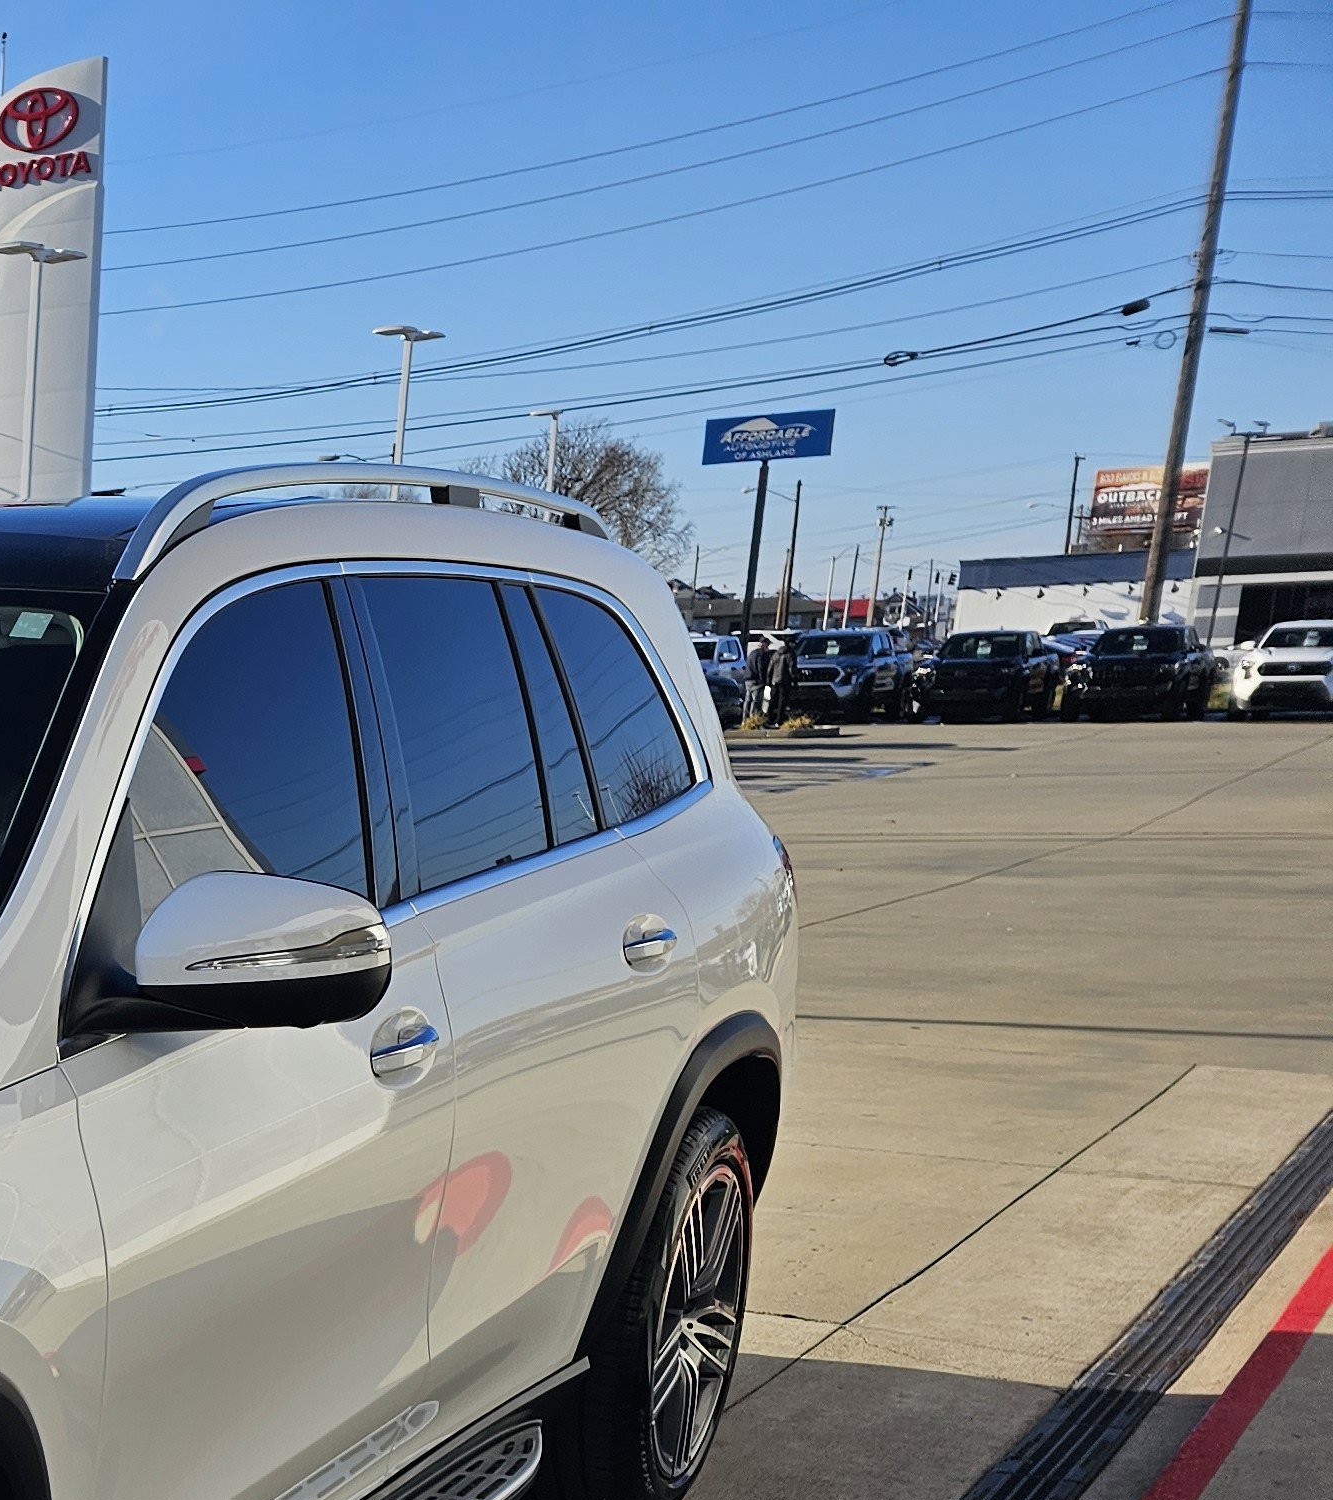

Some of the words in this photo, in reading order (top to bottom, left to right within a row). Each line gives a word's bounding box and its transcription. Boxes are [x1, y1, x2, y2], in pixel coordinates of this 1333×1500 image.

[720, 427, 811, 443] AFFORDABLE
[734, 451, 748, 460] OF
[749, 447, 796, 459] ASHLAND
